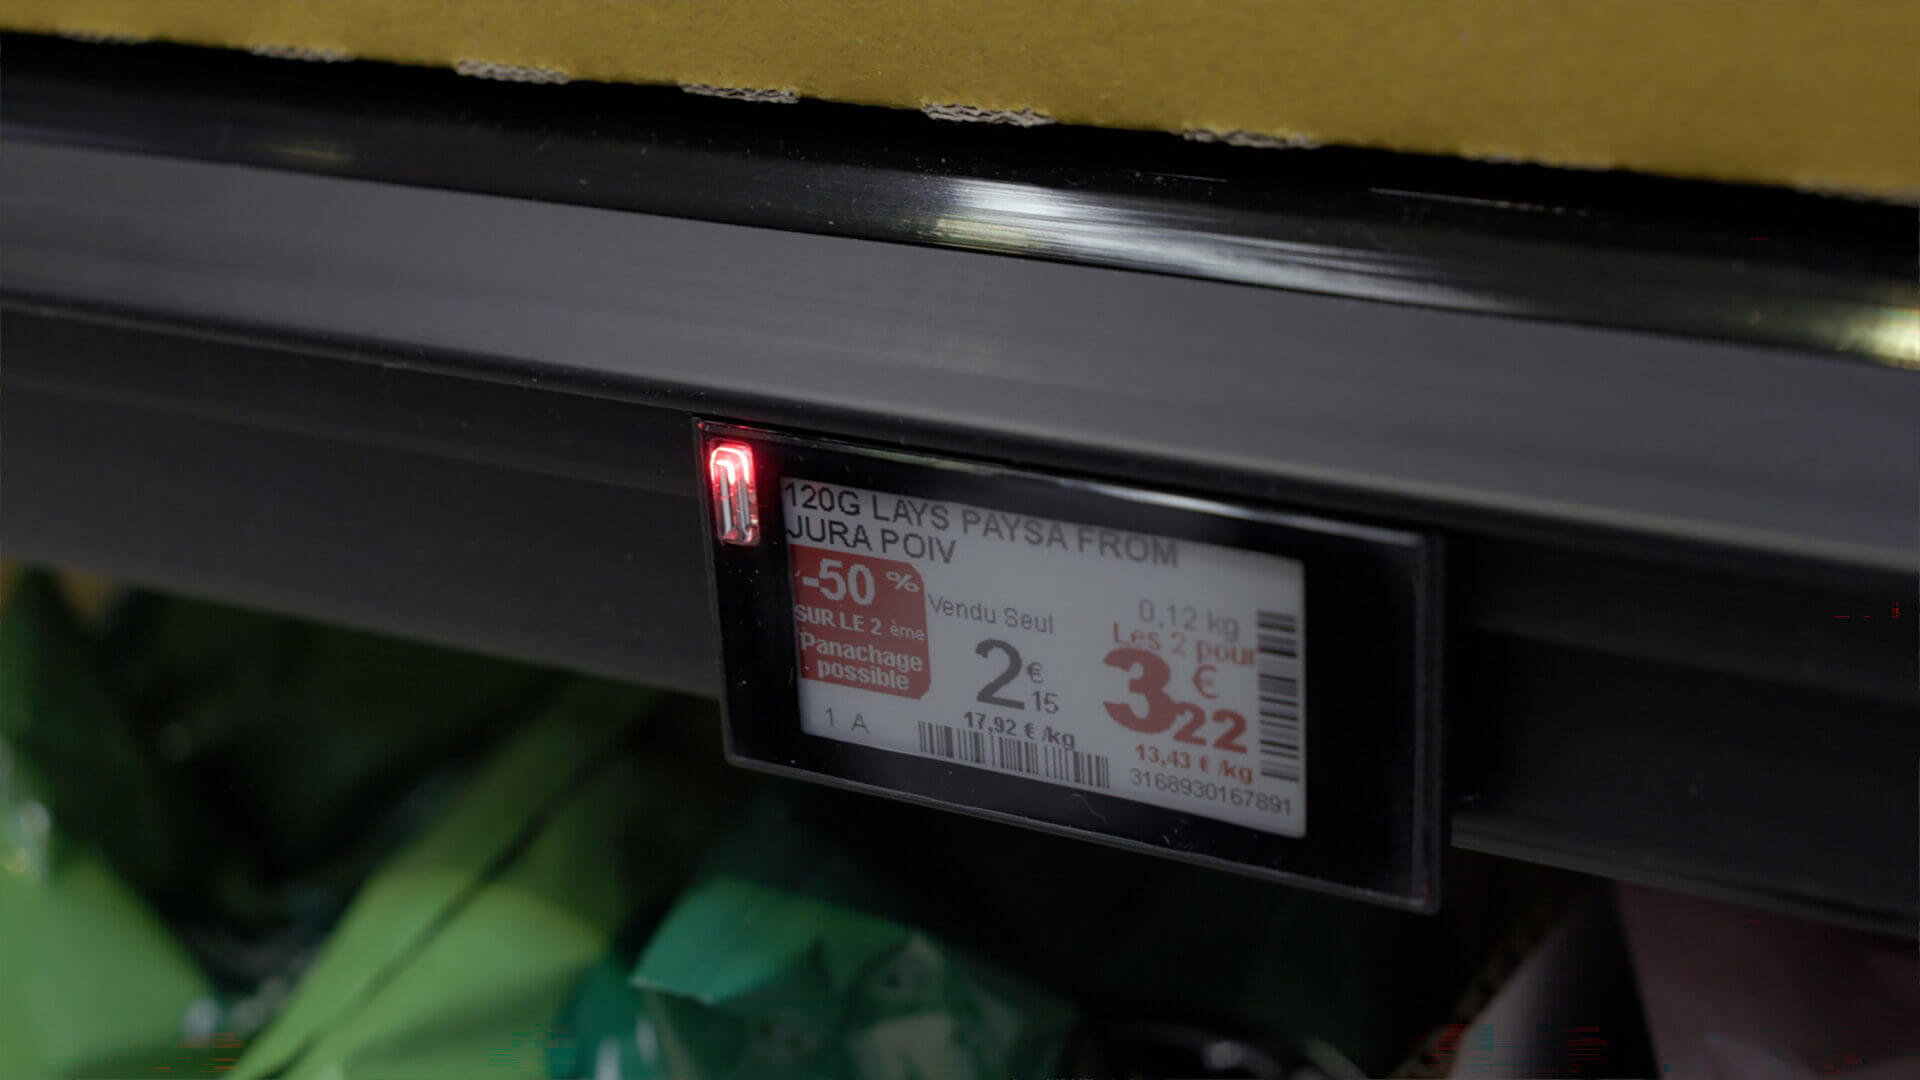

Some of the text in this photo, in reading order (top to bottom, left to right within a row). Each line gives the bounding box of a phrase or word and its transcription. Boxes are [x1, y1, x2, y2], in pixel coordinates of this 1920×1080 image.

[785, 482, 1178, 568] 120G LAYS PAYSA FROM
[785, 516, 955, 563] JURA POIV
[803, 558, 920, 606] -50 %
[794, 604, 925, 640] SUR LE 2 ème
[928, 594, 1053, 634] Vendu Seul
[1139, 599, 1239, 643] 0,12 kg
[801, 632, 923, 673] Panachage
[1113, 621, 1255, 667] Les 2 pour
[817, 660, 909, 690] possible
[975, 638, 1059, 714] 2 € 15
[1192, 664, 1219, 699] €
[825, 707, 870, 734] 1 A
[964, 711, 1075, 751] 17,92 € /kg
[1135, 744, 1253, 785] 13,43 € /kg
[1130, 768, 1291, 814] 3168930167891
